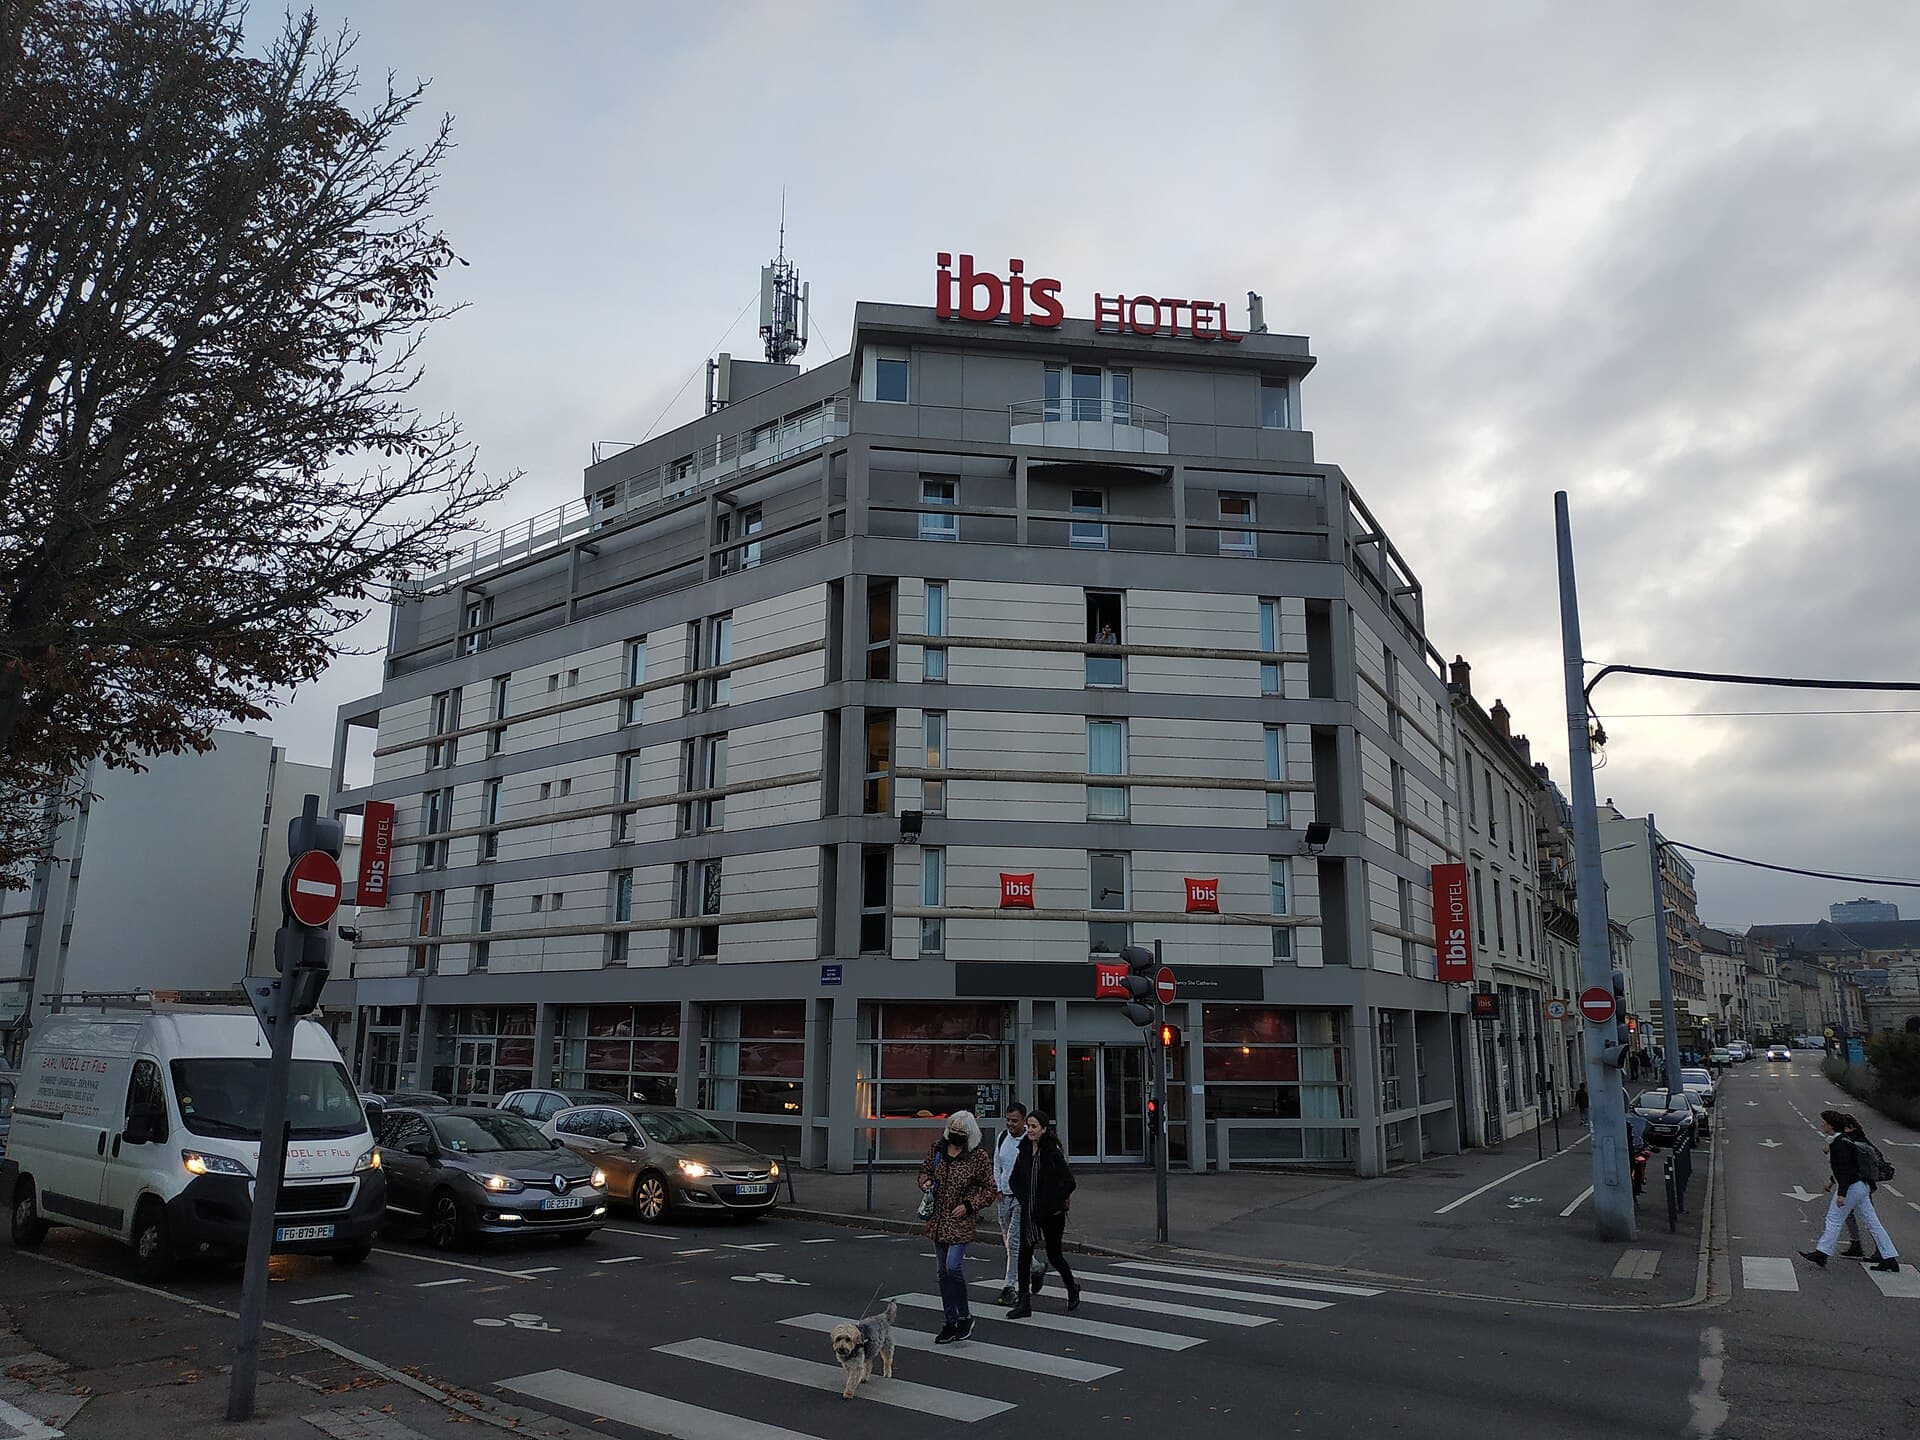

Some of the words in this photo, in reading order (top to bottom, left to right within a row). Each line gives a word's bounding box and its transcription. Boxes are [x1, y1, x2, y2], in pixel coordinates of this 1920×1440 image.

[936, 252, 1065, 326] ibis
[1094, 293, 1244, 343] HOTEL
[365, 860, 385, 893] ibis
[376, 817, 390, 855] HOTEL
[1005, 881, 1031, 896] ibis
[1191, 886, 1216, 901] ibis
[1449, 879, 1464, 923] HOTEL
[1444, 928, 1467, 965] ibis
[1478, 999, 1492, 1008] ibis
[283, 1226, 329, 1240] FG-879-PE
